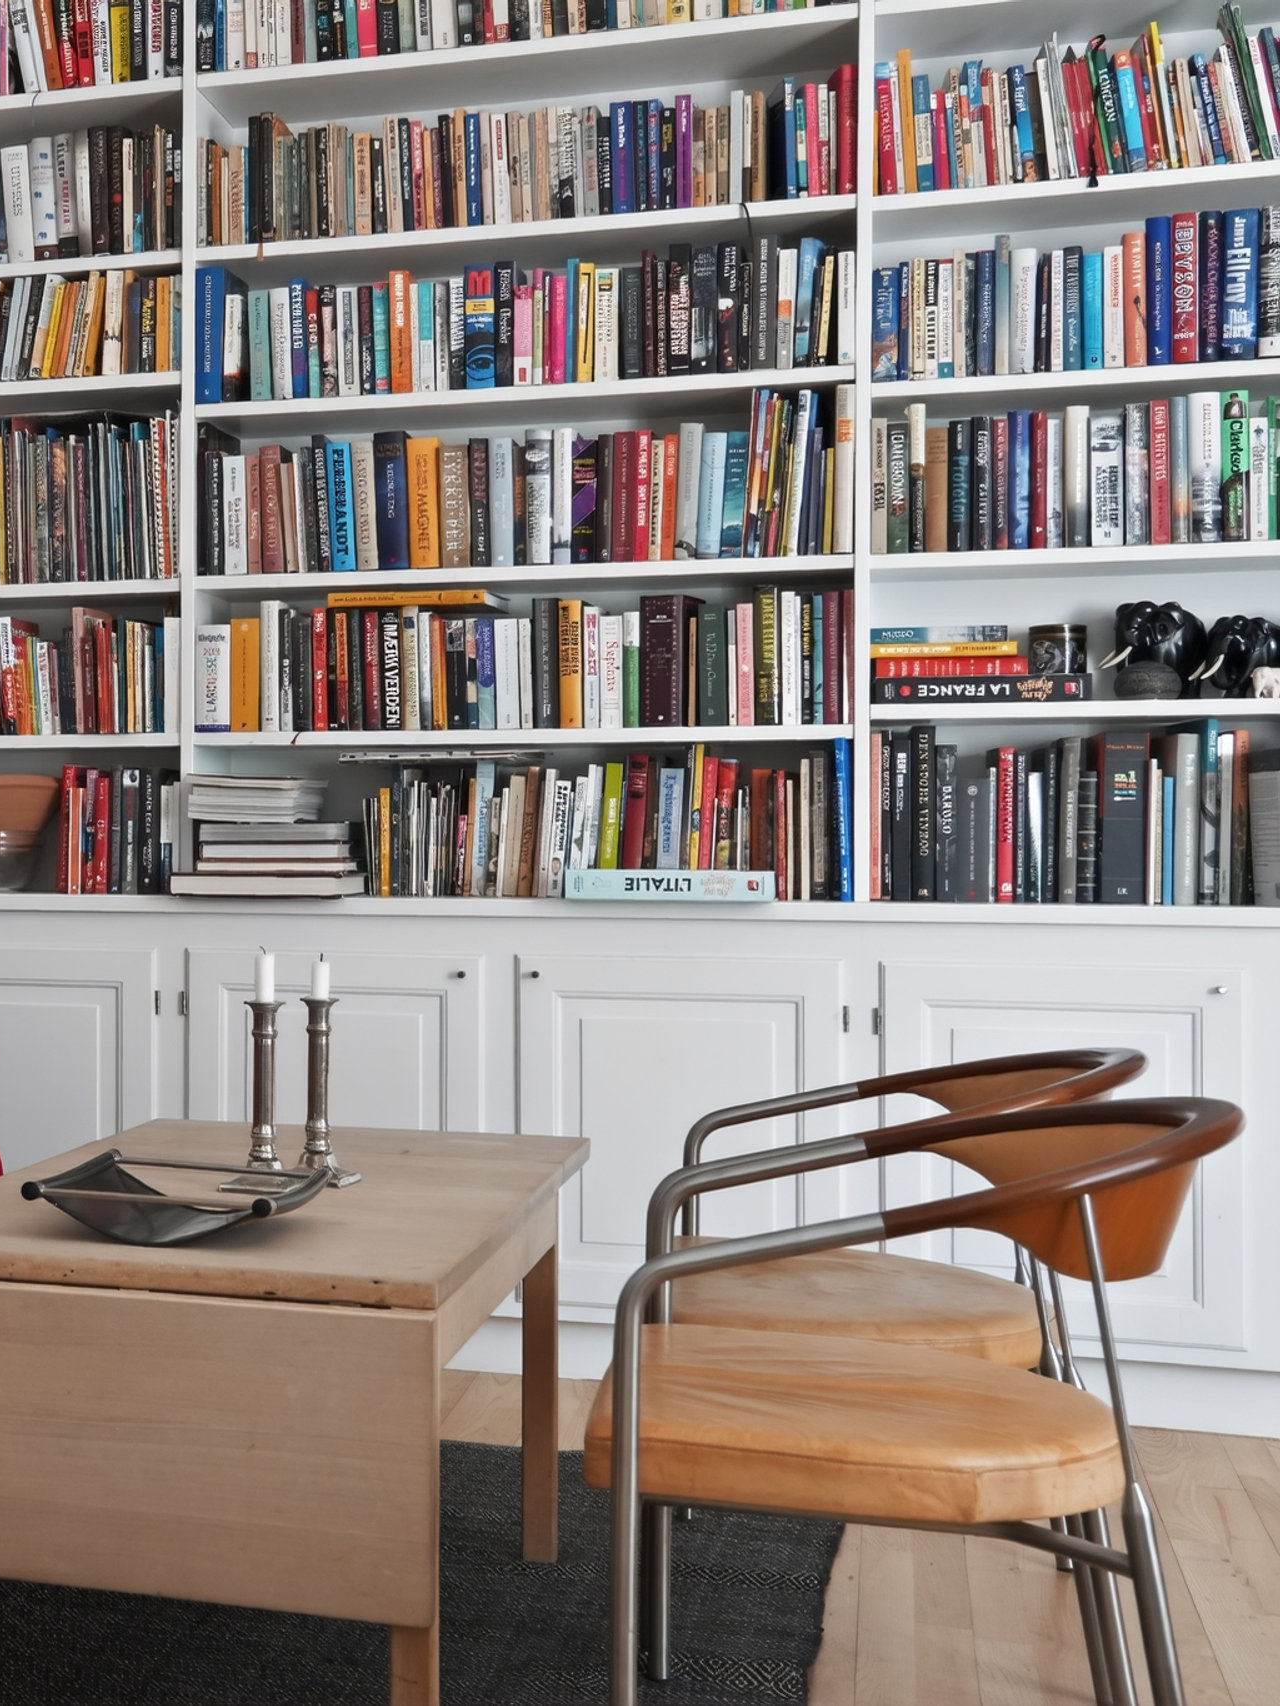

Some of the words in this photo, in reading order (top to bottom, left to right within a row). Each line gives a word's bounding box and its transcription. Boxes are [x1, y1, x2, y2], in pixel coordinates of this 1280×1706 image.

[917, 683, 986, 697] FRANCE
[990, 684, 1010, 696] LA
[624, 877, 692, 892] L'ITALIE
